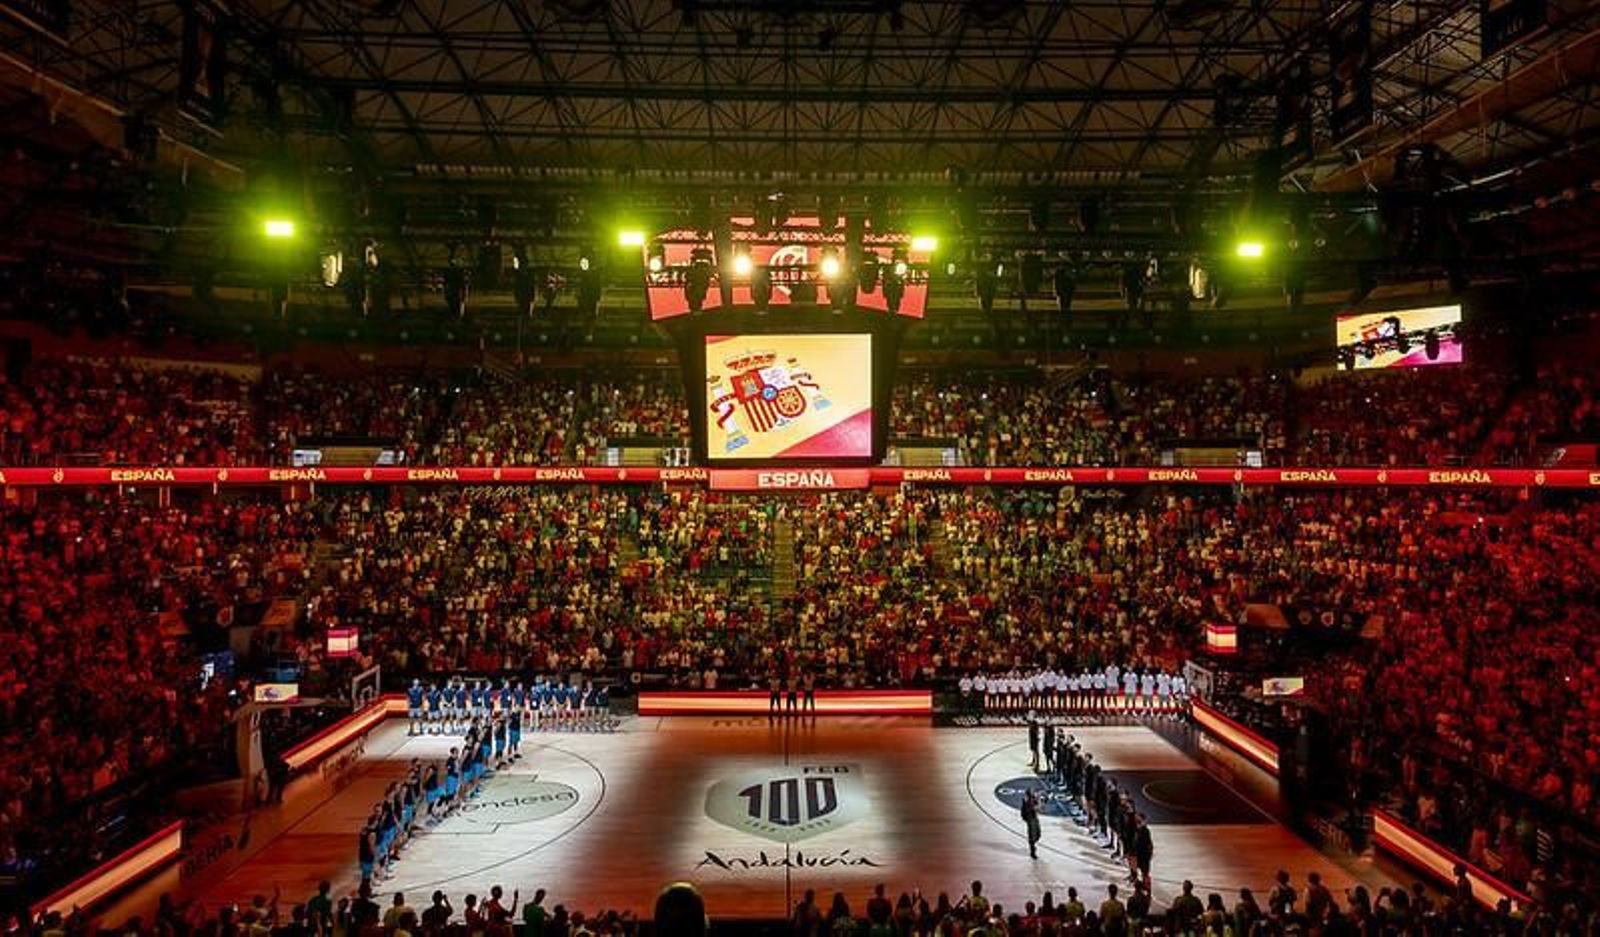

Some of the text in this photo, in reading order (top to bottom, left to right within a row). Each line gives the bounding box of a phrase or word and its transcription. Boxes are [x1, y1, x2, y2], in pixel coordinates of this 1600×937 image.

[111, 468, 175, 481] ESPAÑA
[269, 468, 326, 481] ESPAÑA
[408, 468, 459, 480] ESPAÑA
[535, 468, 585, 480] ESPAÑA
[660, 468, 707, 480] ESPAÑA
[757, 470, 835, 487] ESPAÑA
[903, 469, 951, 481] ESPAÑA
[1024, 470, 1073, 481] ESPAÑA
[1148, 470, 1198, 481] ESPAÑA
[1280, 470, 1337, 481] ESPAÑA
[1429, 470, 1491, 483] ESPAÑA
[695, 848, 884, 871] Andalucía
